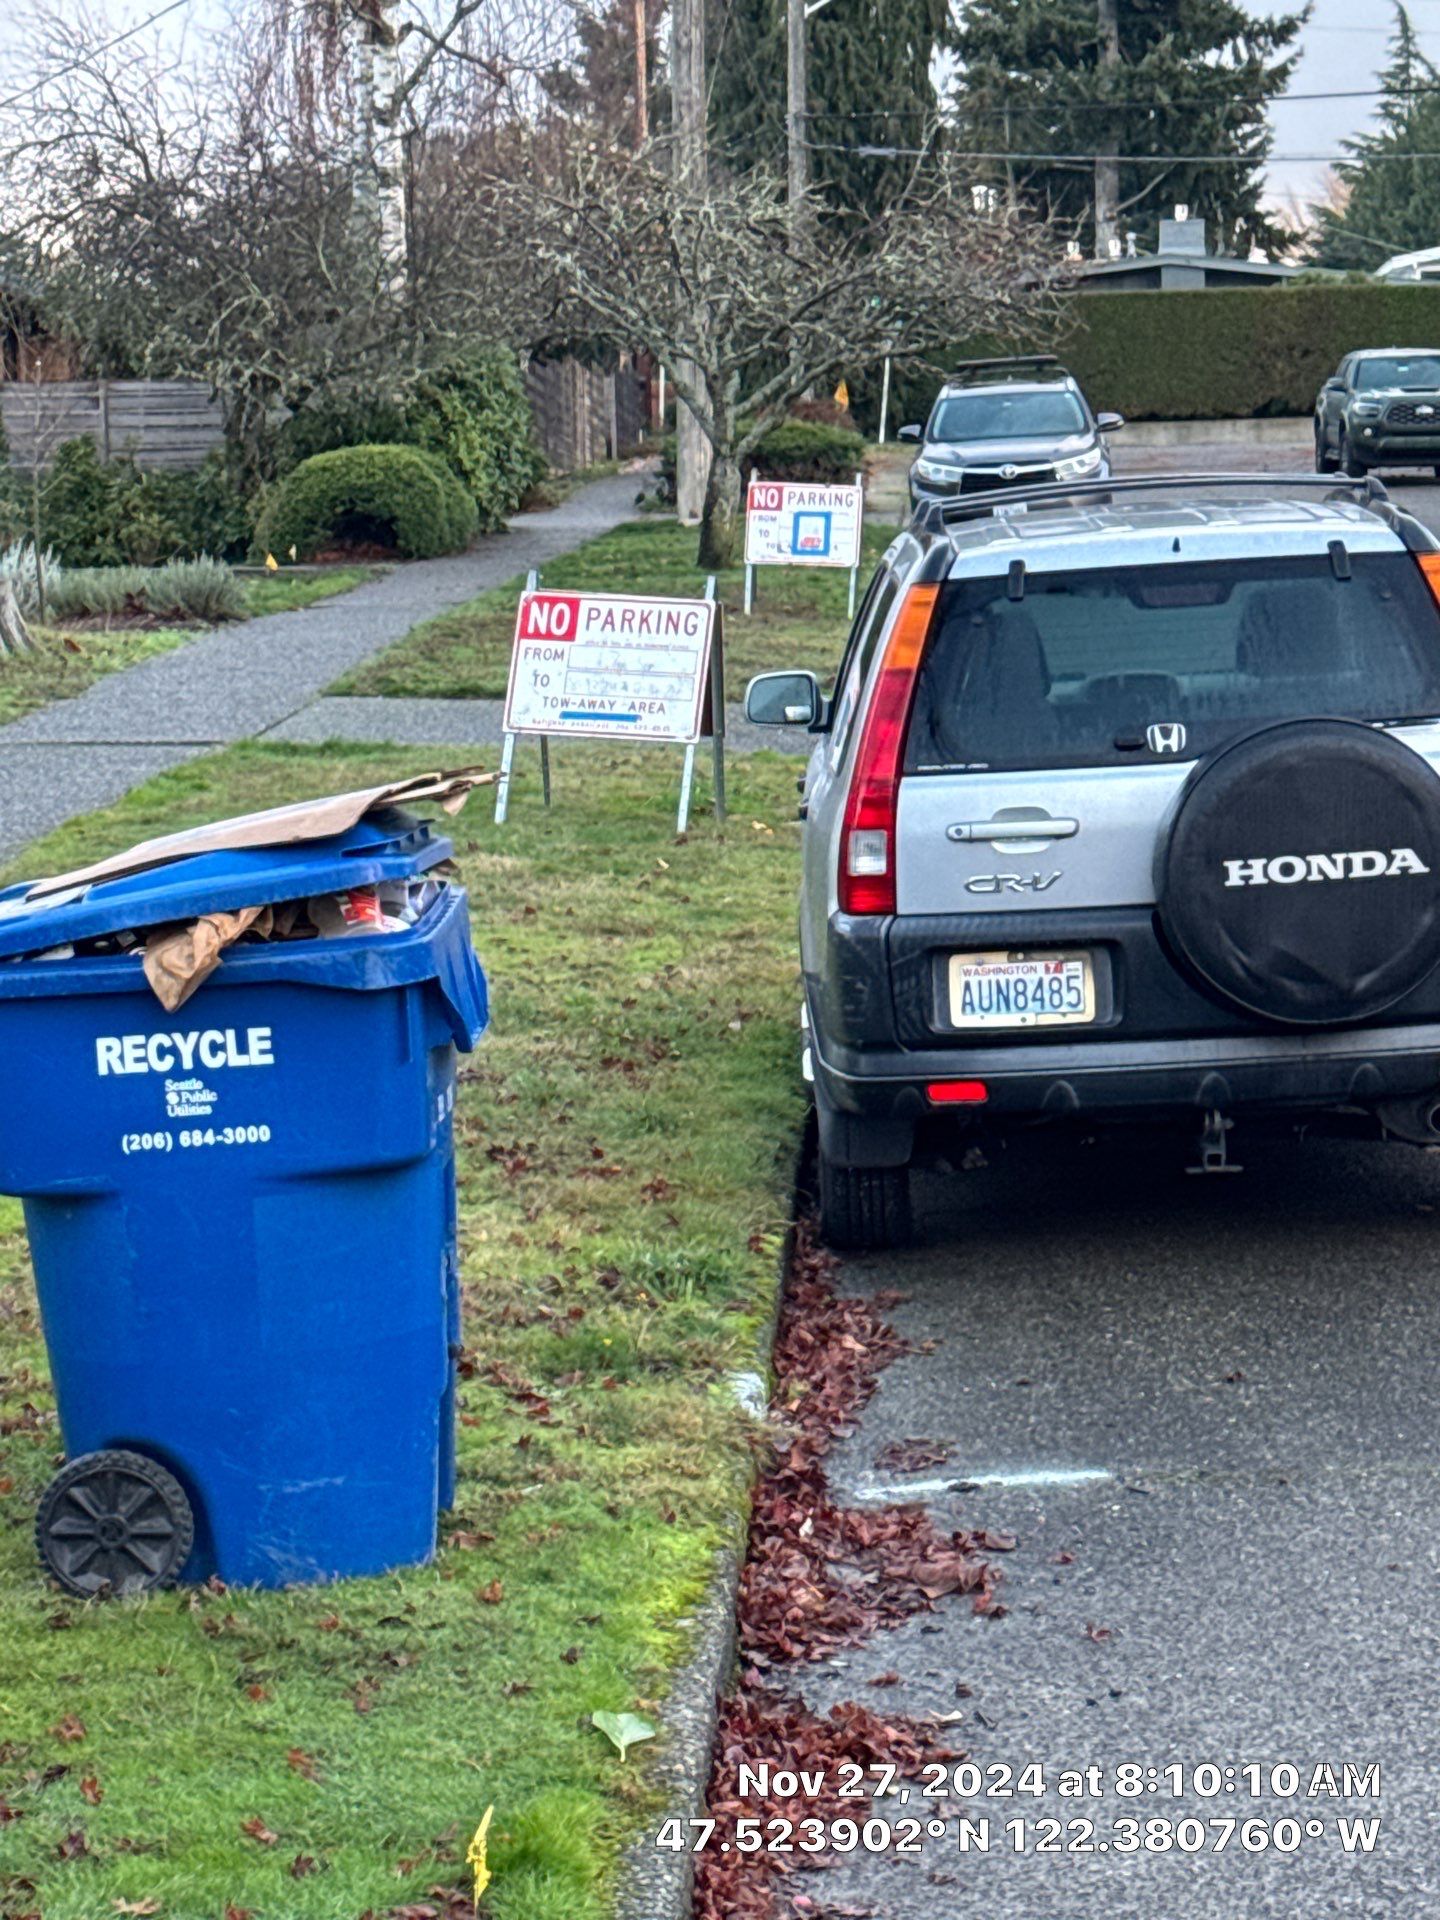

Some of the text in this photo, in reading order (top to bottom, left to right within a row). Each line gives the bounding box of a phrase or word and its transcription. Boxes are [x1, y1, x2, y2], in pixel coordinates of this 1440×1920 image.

[753, 487, 854, 509] NO PARKING
[527, 600, 699, 636] NO PARKING
[524, 646, 565, 662] FROM
[533, 672, 550, 688] TO
[543, 696, 666, 715] TOW-AWAY AREA
[1224, 847, 1430, 887] HONDA
[964, 870, 1062, 894] CR-V
[962, 964, 1038, 977] WASHINGTON
[961, 974, 1082, 1013] AUN8485
[96, 1026, 275, 1077] RECYCLE
[164, 1078, 204, 1092] Seattle
[181, 1089, 218, 1104] Public
[166, 1104, 213, 1118] Utilities
[121, 1124, 272, 1156] (206) 684-3000
